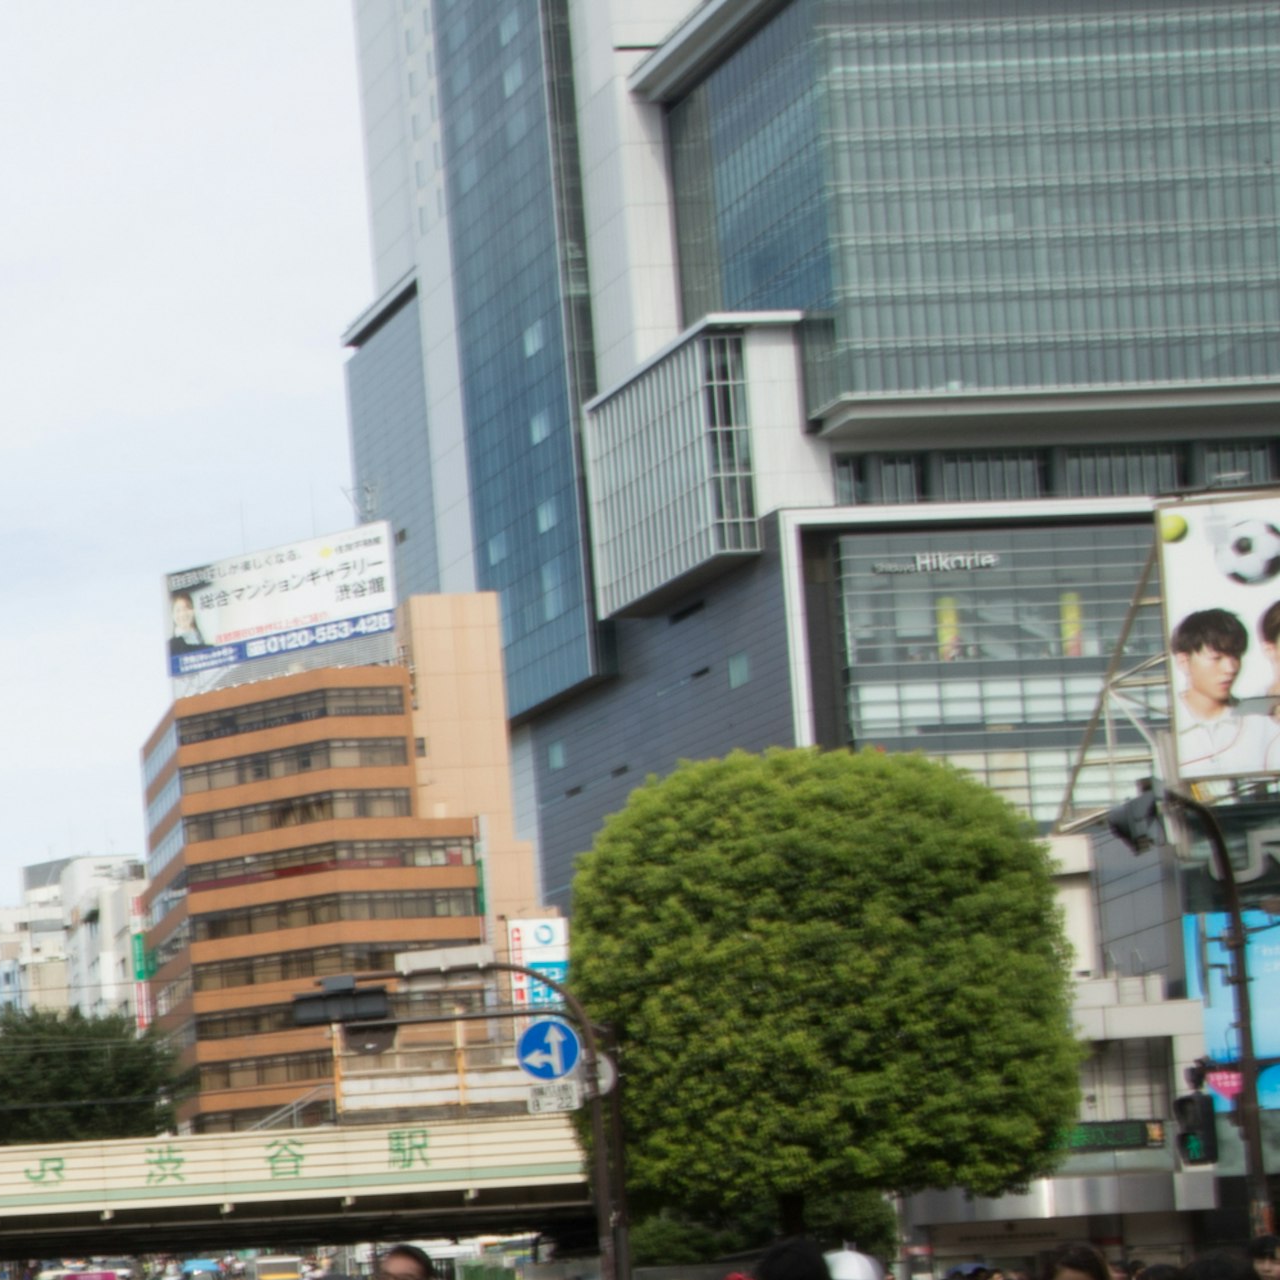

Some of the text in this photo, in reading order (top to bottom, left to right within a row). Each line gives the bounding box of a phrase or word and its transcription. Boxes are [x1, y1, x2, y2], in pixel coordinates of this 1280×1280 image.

[199, 558, 384, 609] 総合マンションギャラリー
[915, 550, 998, 573] Hikarie
[266, 612, 392, 654] 0120-553-428
[25, 1129, 431, 1185] JR 渋谷駅
